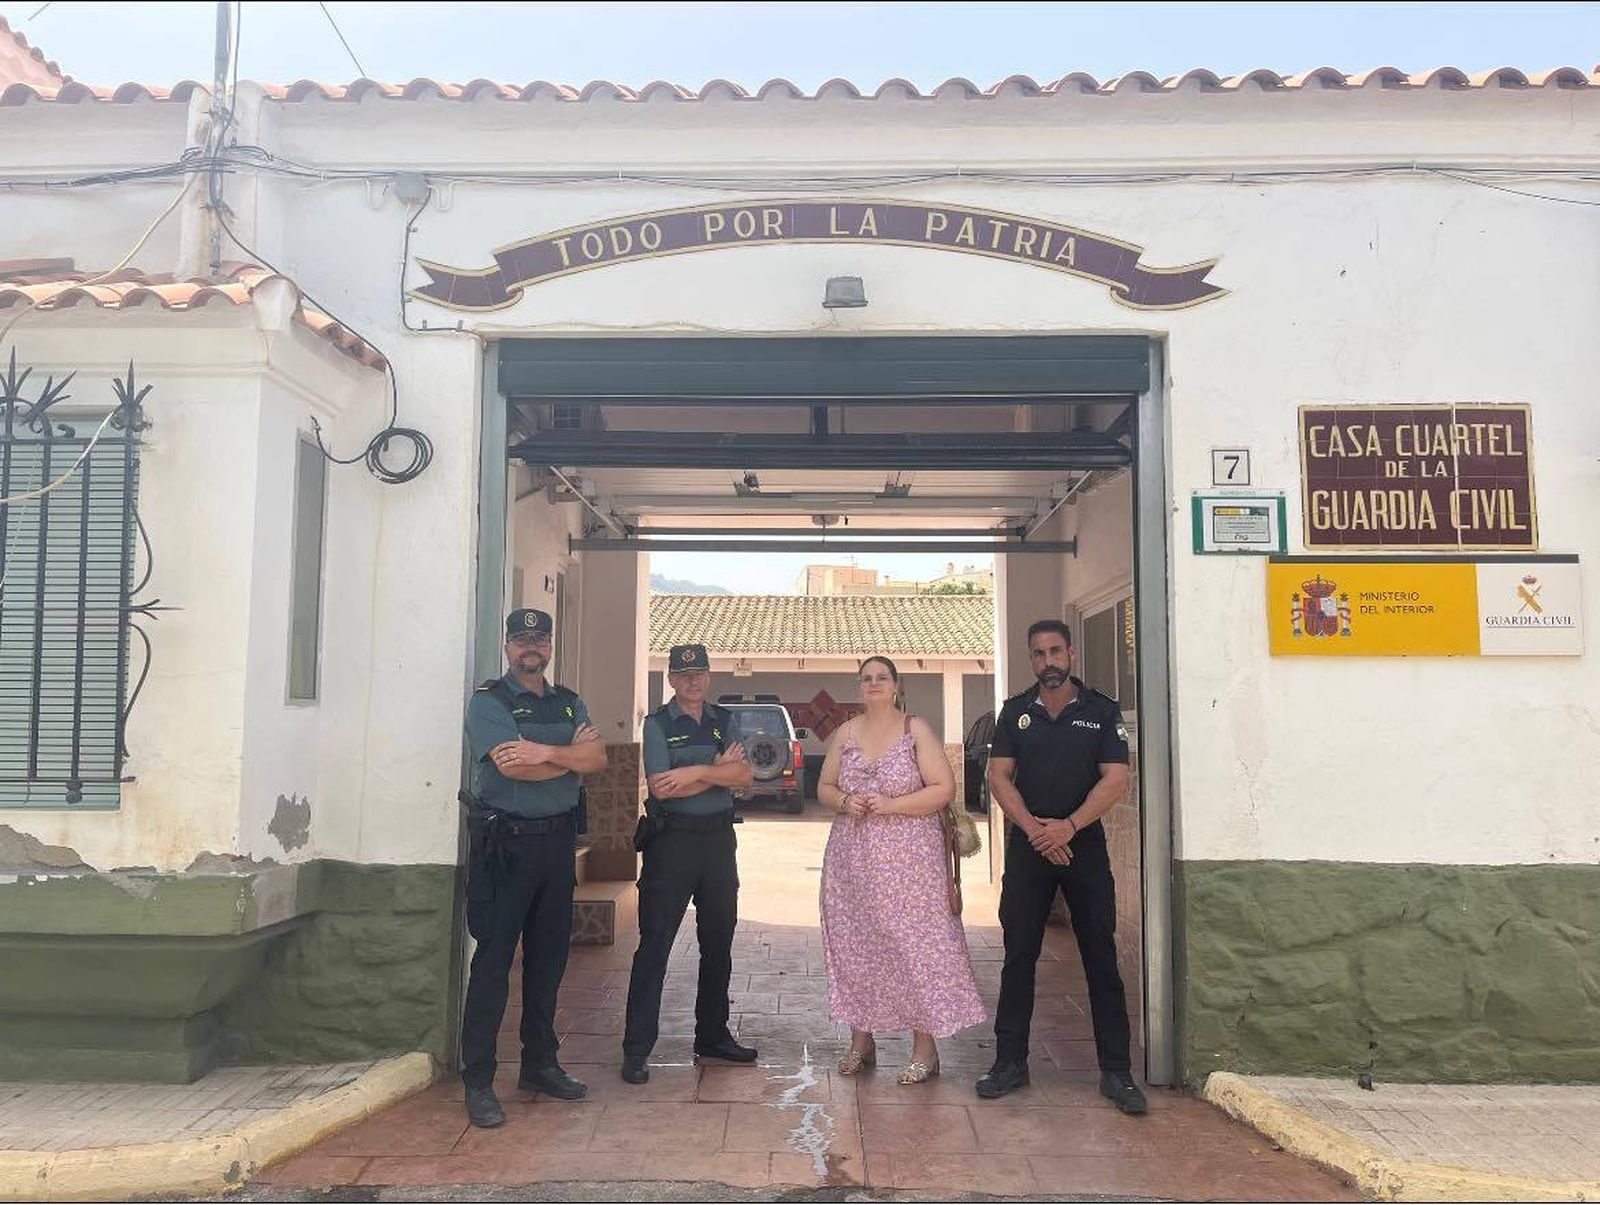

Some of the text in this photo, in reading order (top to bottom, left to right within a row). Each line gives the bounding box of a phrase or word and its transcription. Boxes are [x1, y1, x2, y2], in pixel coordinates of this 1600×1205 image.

[552, 206, 1078, 268] TODO POR LA PATRIA
[1309, 423, 1524, 458] CASA CUARTEL
[1223, 455, 1240, 480] 7
[1385, 460, 1448, 478] DE LA
[1312, 489, 1437, 531] GUARDIA
[1450, 488, 1527, 530] CIVIL
[1359, 591, 1421, 602] MINISTERIO
[1359, 604, 1435, 615] DEL INTERIOR
[1485, 615, 1577, 626] GUARDIA CIVIL
